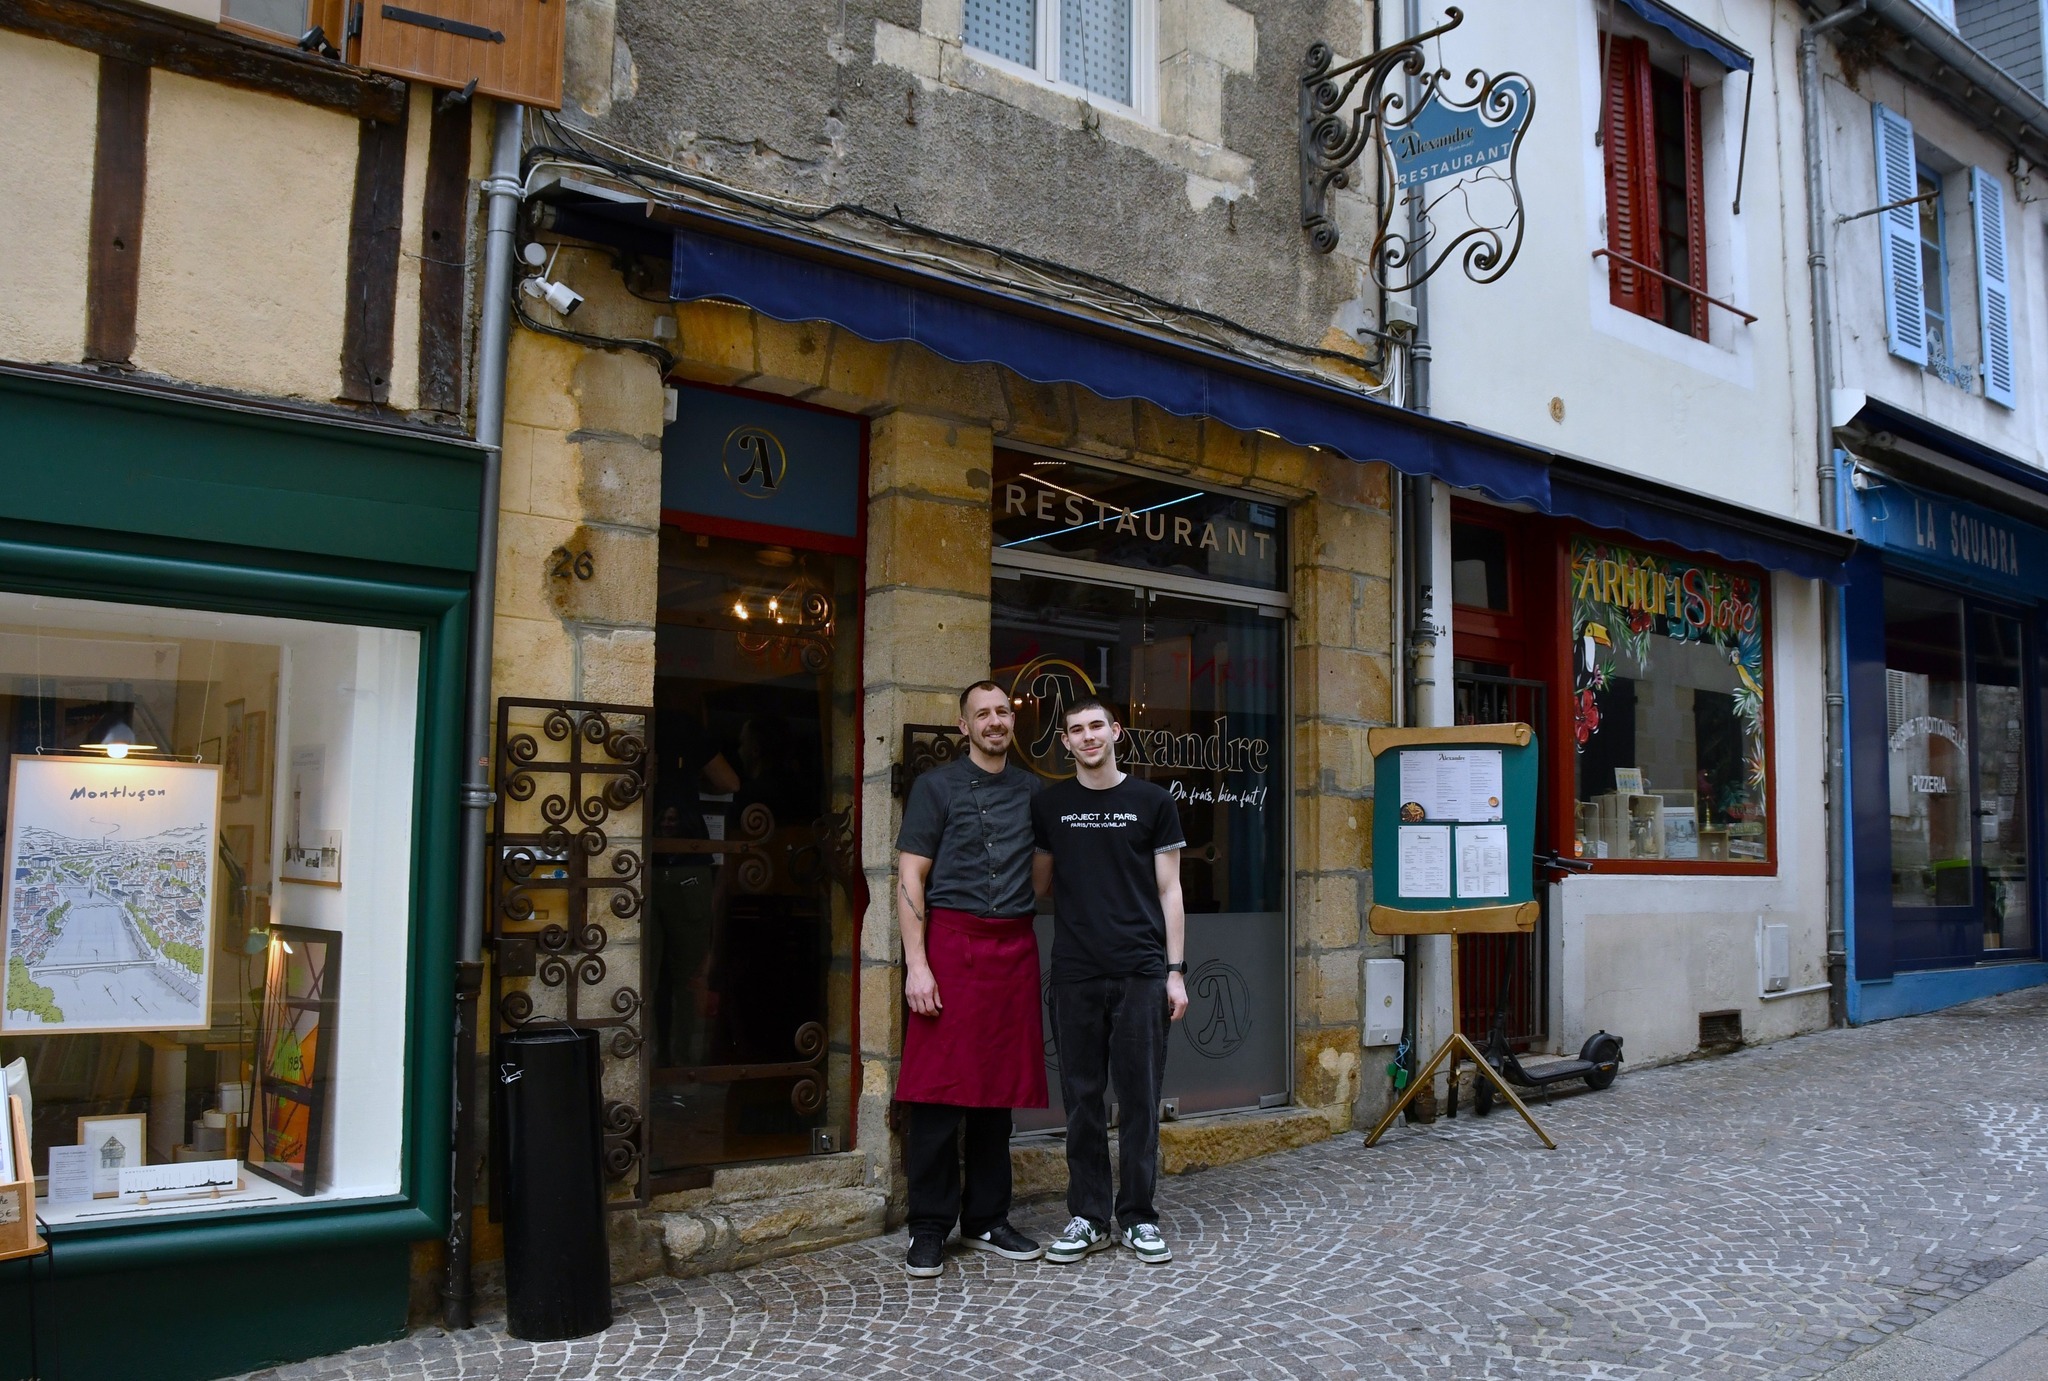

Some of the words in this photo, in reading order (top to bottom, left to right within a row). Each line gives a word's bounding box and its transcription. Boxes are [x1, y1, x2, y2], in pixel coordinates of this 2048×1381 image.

[1401, 127, 1474, 159] Alexandre
[1399, 142, 1510, 186] RESTAURANT
[737, 434, 778, 490] A
[1005, 483, 1270, 560] RESTAURANT
[1915, 498, 1936, 551] LA
[1951, 511, 2018, 577] SQUADRA
[550, 546, 594, 581] 26
[1683, 568, 1756, 633] Store
[1433, 624, 1447, 637] 24
[1030, 673, 1269, 774] Axandre
[69, 785, 166, 802] Montluçon
[1189, 786, 1215, 806] frais,
[1217, 782, 1238, 803] bien
[1911, 775, 1948, 794] PIZZERIA
[1061, 813, 1100, 823] PROJECT
[1104, 812, 1110, 821] X
[1113, 813, 1137, 822] PARIS
[1197, 974, 1242, 1046] A
